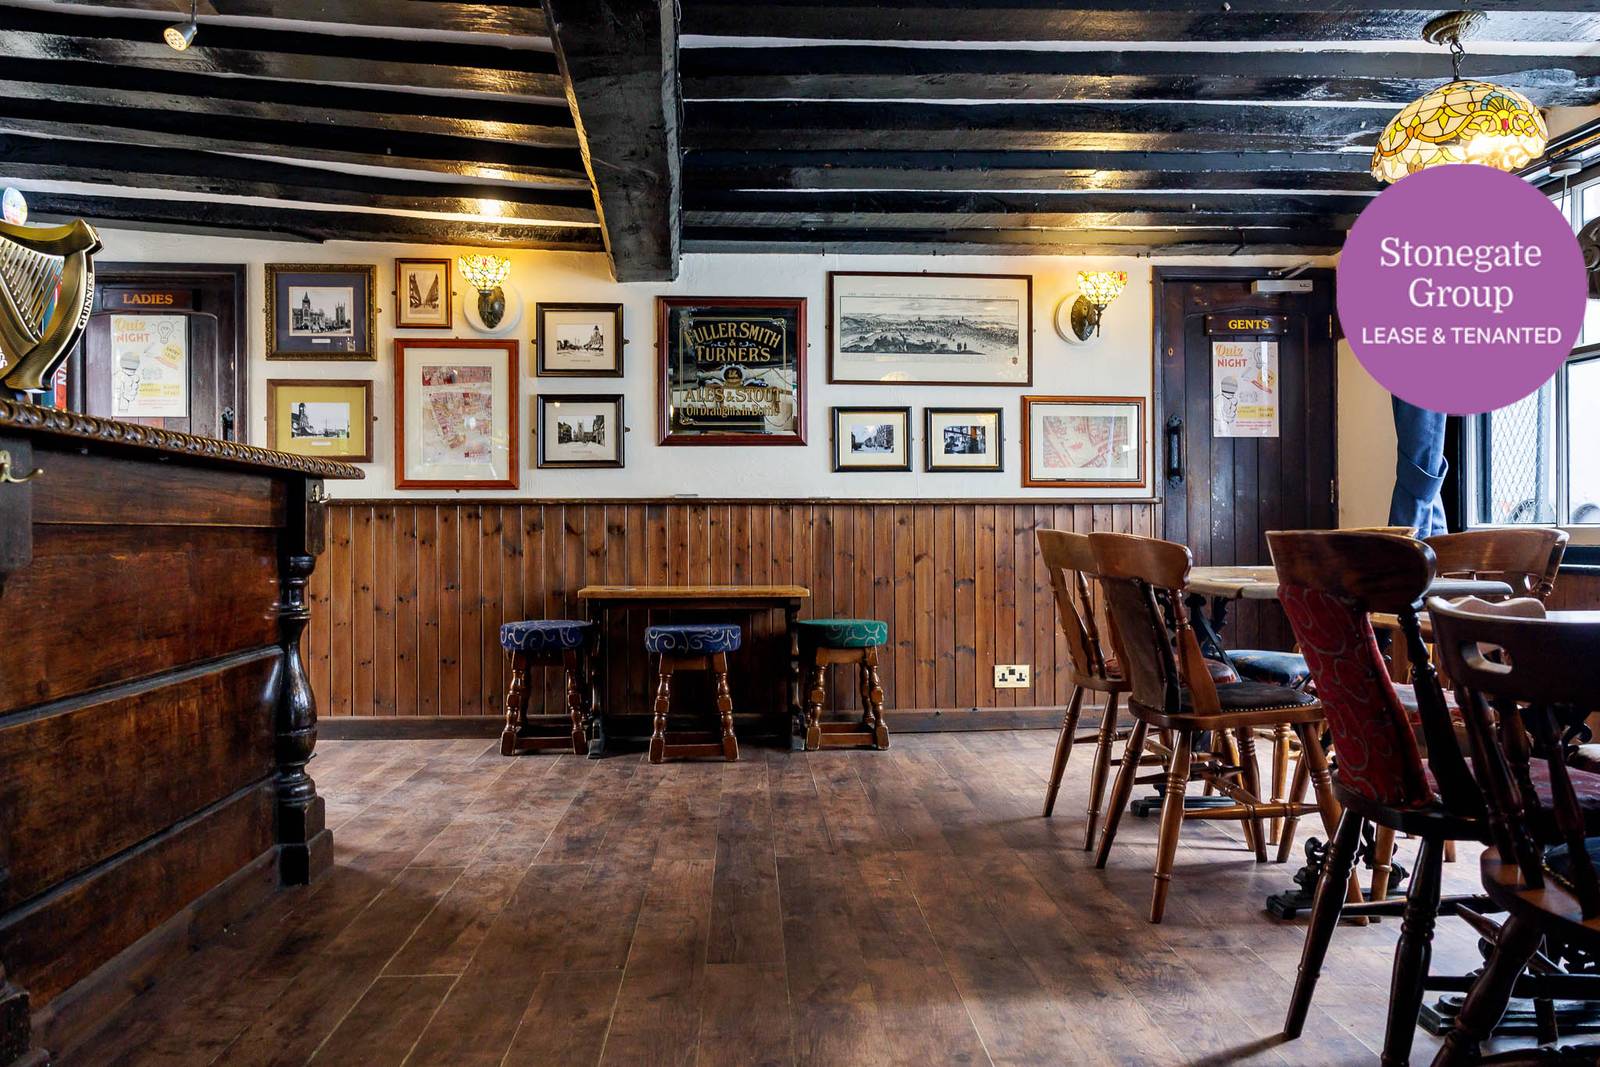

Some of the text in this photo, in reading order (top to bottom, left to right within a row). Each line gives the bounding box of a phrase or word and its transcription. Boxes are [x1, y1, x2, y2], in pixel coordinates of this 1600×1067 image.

[78, 271, 94, 329] GUINNESS
[123, 294, 173, 305] LADIES
[1228, 319, 1270, 330] GENTS
[117, 333, 150, 343] NIGHT
[740, 322, 781, 348] SMITH
[729, 338, 736, 347] &
[695, 346, 770, 362] TURNER'S
[1217, 358, 1248, 368] NIGHT
[683, 387, 724, 403] ALES
[735, 387, 781, 403] STOUT
[686, 404, 699, 417] On
